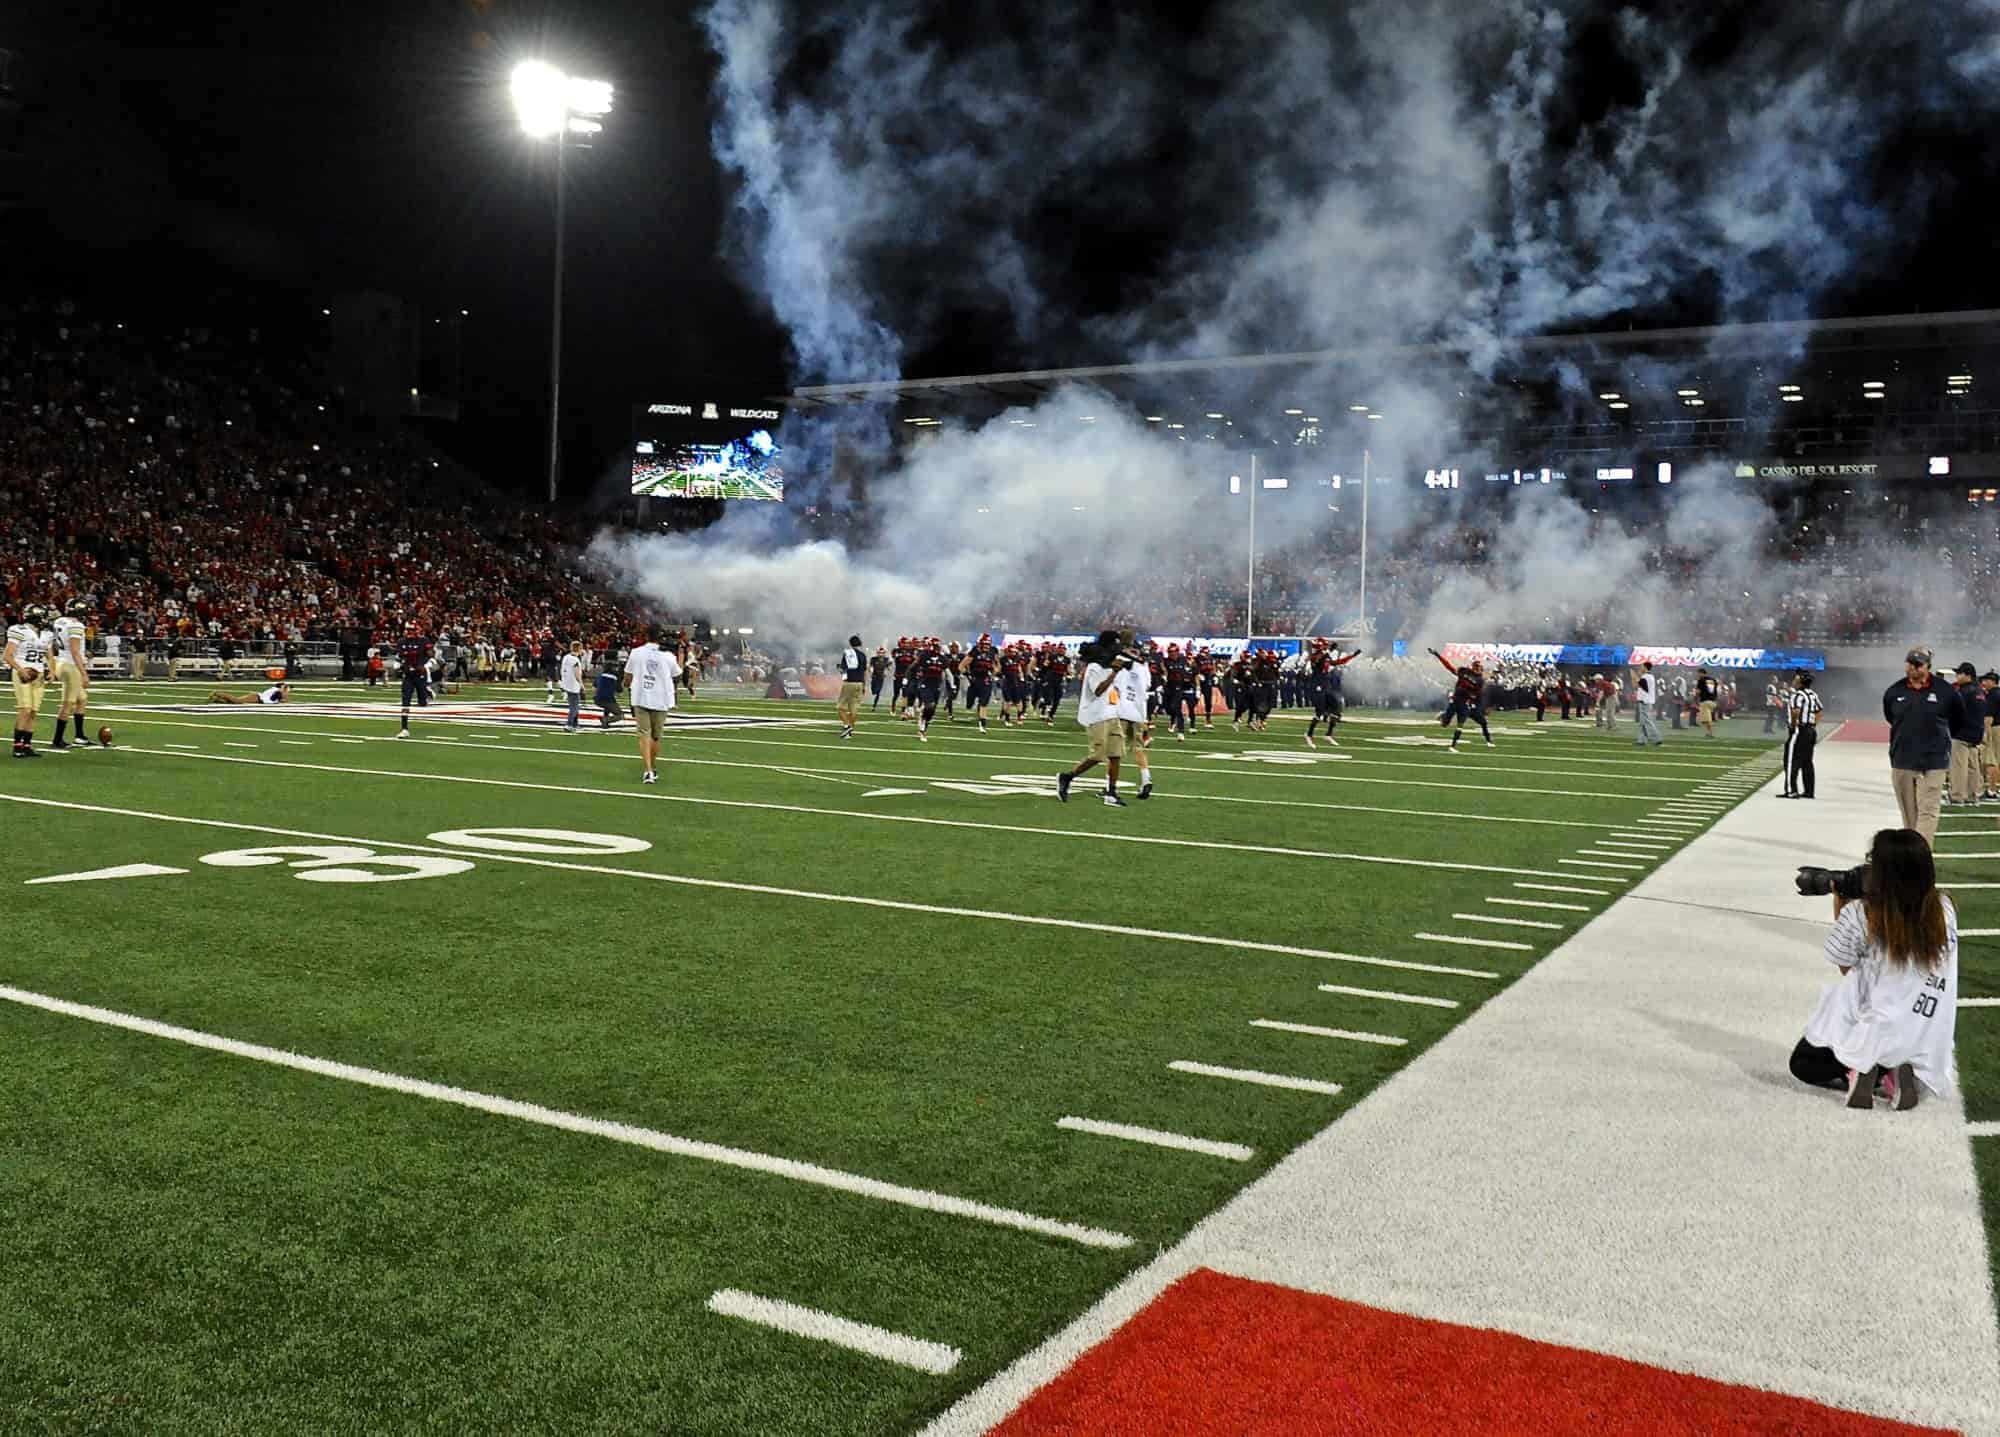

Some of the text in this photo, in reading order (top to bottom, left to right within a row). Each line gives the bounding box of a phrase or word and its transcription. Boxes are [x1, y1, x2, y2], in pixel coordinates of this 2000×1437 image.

[648, 404, 692, 415] ARIZONA
[730, 408, 779, 420] WILDCATS
[1424, 469, 1459, 488] 4:41
[1760, 464, 1879, 477] CASINO DEL SOL RESORT
[198, 827, 653, 883] 30
[1912, 992, 1938, 1018] 80
